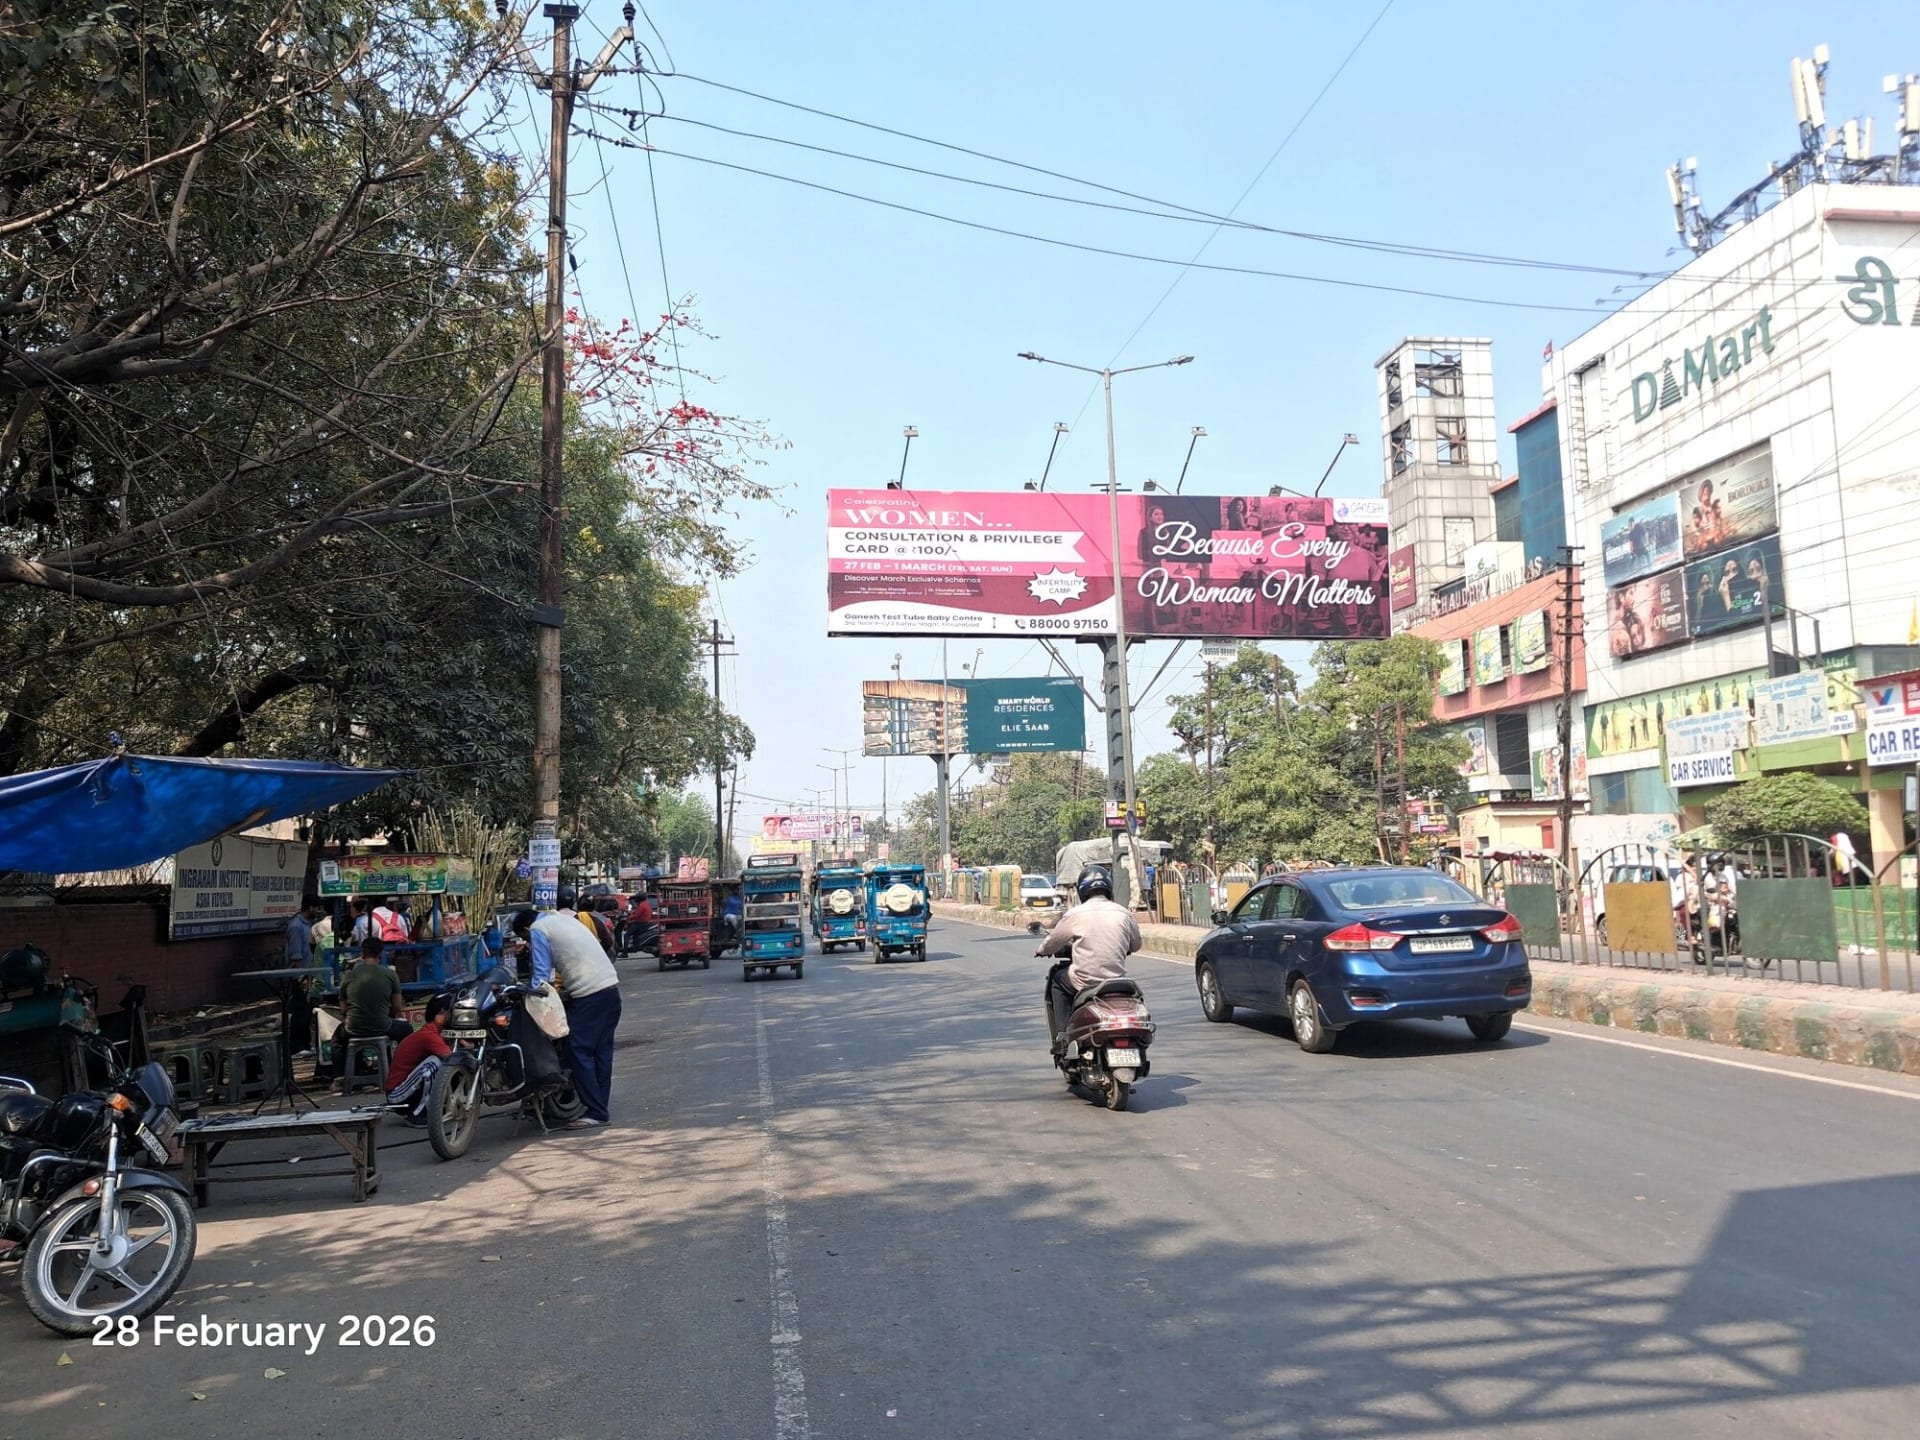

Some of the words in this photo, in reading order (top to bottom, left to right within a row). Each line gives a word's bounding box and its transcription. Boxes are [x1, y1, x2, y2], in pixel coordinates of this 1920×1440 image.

[844, 498, 919, 508] Celebrating
[845, 531, 964, 543] CONSULTATION
[969, 534, 979, 543] &
[984, 534, 1063, 544] PRIVILEGE
[845, 544, 889, 554] CARD
[895, 545, 908, 556] @
[1152, 521, 1264, 558] Because
[1271, 522, 1351, 569] Every
[844, 562, 858, 570] 27
[861, 562, 881, 571] FEB
[901, 563, 945, 572] MARCH
[1138, 567, 1255, 607] Woman
[1262, 569, 1375, 608] Matters
[1030, 619, 1070, 629] 88000
[1073, 619, 1109, 629] 97150
[994, 704, 1055, 713] RESIDENCES
[1001, 724, 1021, 732] ELIE
[1025, 724, 1050, 732] SAAB
[1869, 731, 1897, 755] CAR
[1671, 761, 1689, 782] CAR
[1692, 756, 1732, 779] SERVICE
[179, 869, 217, 888] INGRAHAM
[218, 869, 249, 888] INSTITUTE
